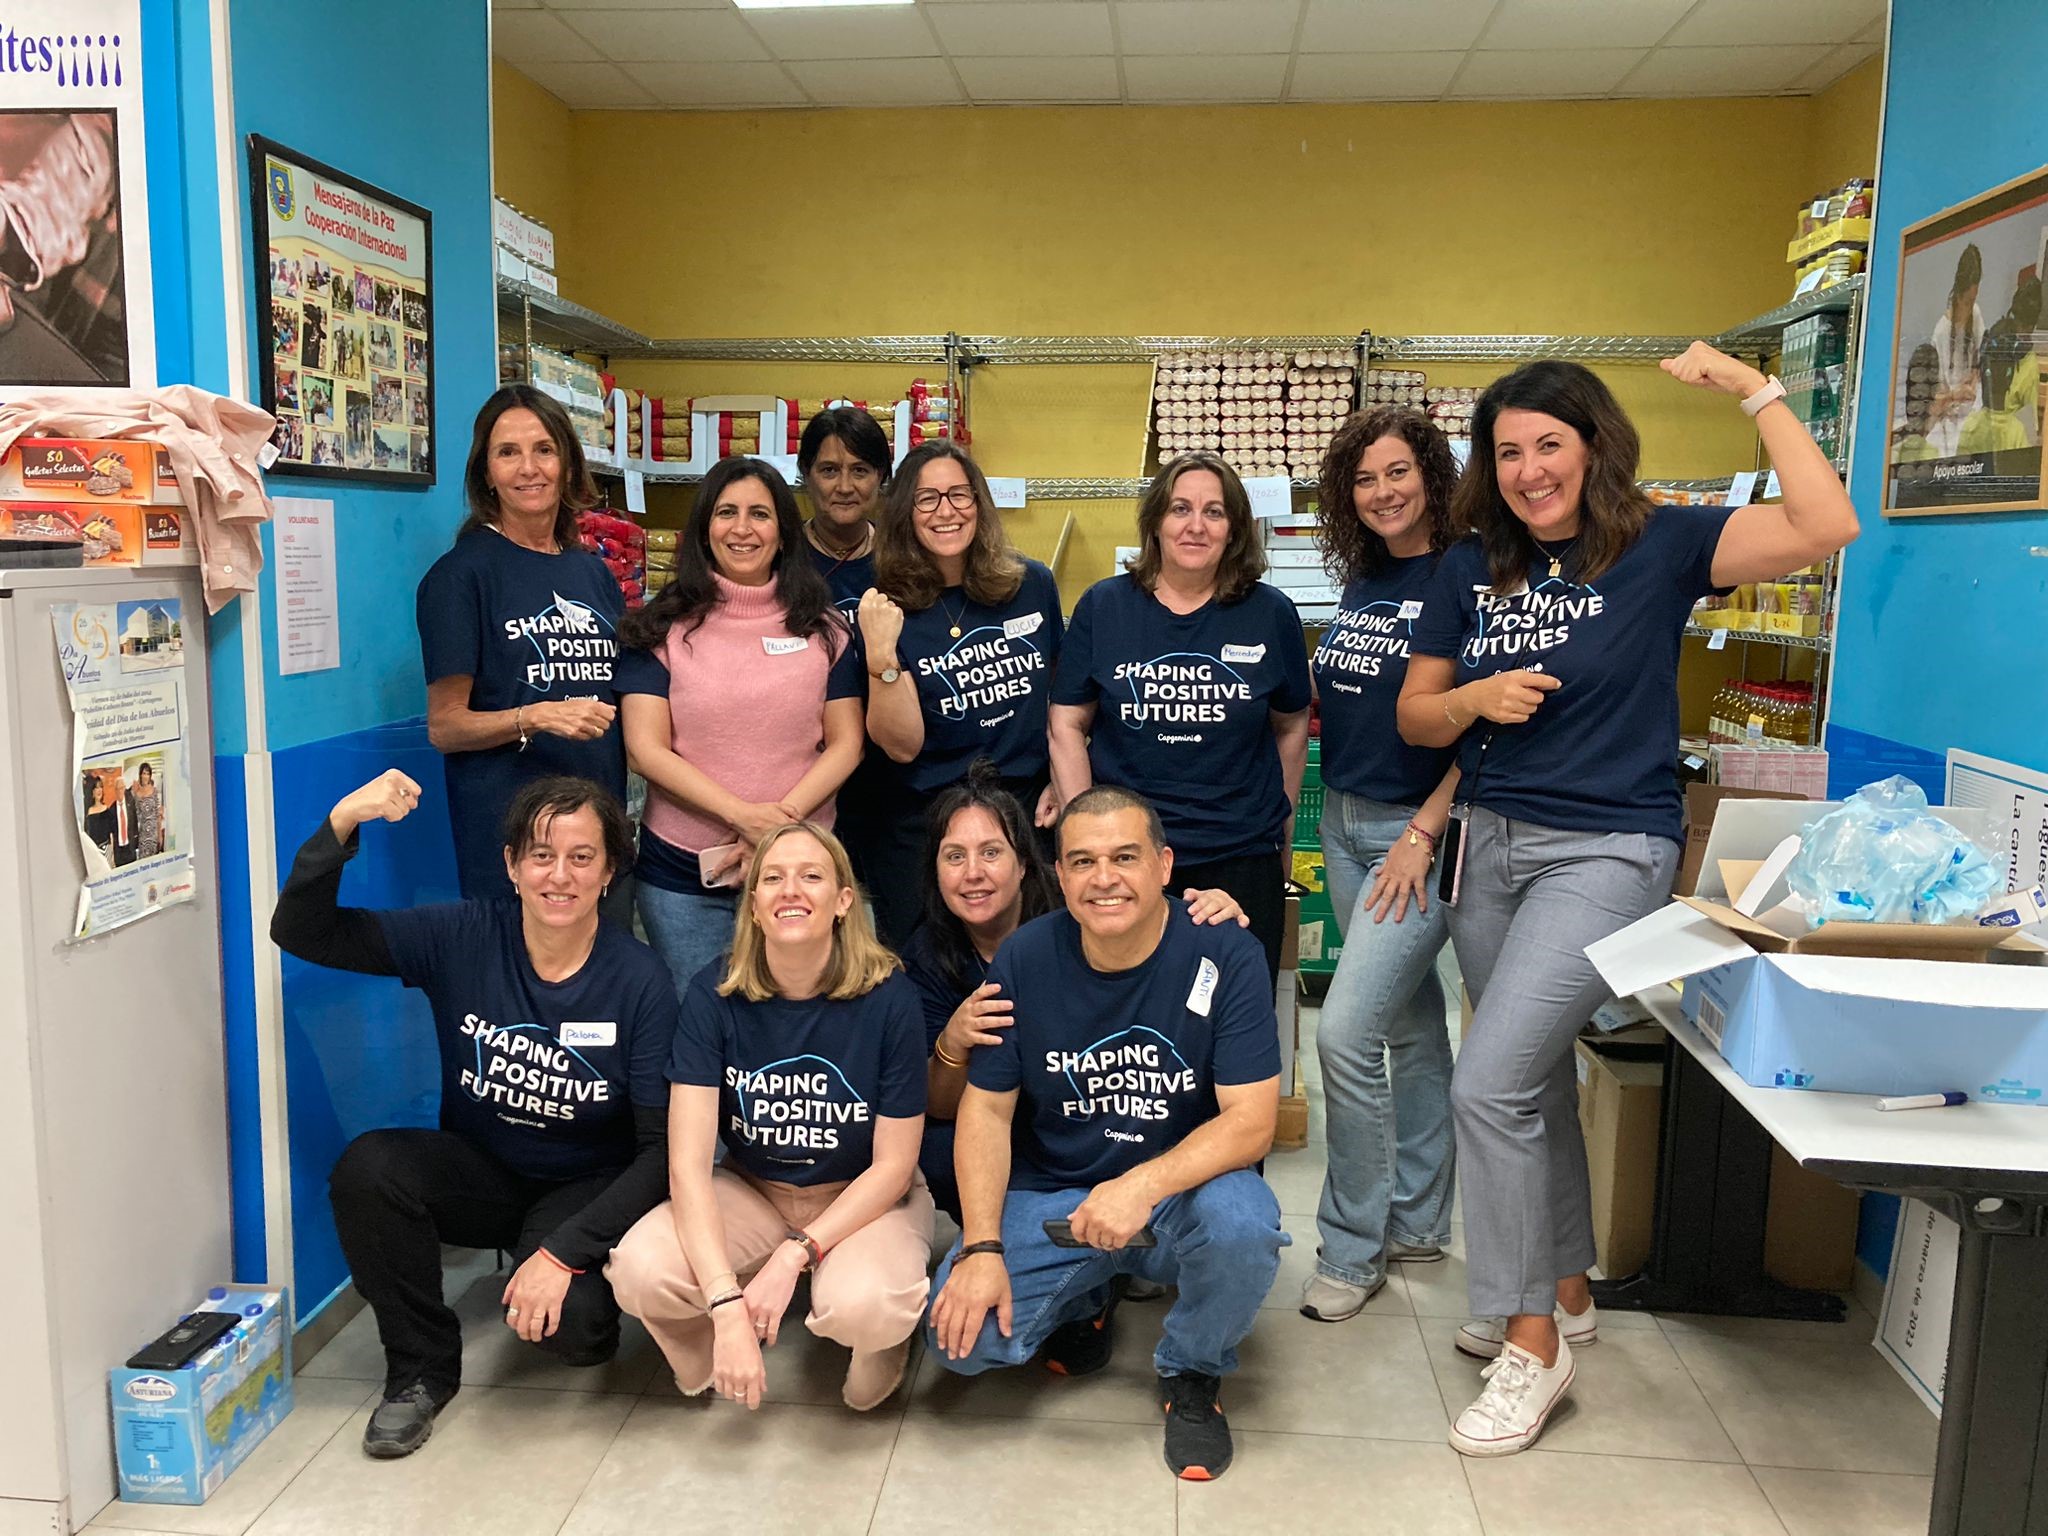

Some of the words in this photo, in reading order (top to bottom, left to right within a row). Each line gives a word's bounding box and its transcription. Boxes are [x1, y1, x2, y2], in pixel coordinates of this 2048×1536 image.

[313, 181, 361, 218] Mensajeros
[361, 201, 371, 222] de
[371, 204, 379, 226] la
[380, 210, 396, 232] Paz
[304, 205, 357, 242] Cooperación
[357, 226, 408, 262] Internacional
[46, 450, 64, 462] 80
[24, 465, 53, 478] Galletas
[53, 463, 85, 475] Selectas
[1933, 464, 1956, 480] Apoyo
[1956, 460, 1985, 476] escolar
[504, 615, 600, 641] SHAPING
[1006, 616, 1038, 636] LUCIE
[546, 637, 619, 659] POSITIV
[917, 637, 1010, 676] SHAPING
[1312, 645, 1383, 677] FUTURES
[526, 662, 613, 684] FUTURES
[955, 651, 1045, 689] POSITIVE
[1112, 661, 1212, 681] SHAPING
[939, 676, 1033, 715] FUTURES
[1143, 682, 1253, 701] POSITIVE
[105, 715, 116, 726] del
[129, 711, 138, 721] de
[149, 706, 176, 718] Abuelos
[1120, 702, 1226, 722] FUTURES
[1157, 733, 1194, 744] Capgemini
[2013, 793, 2025, 819] La
[459, 1013, 571, 1073] SHAPING
[565, 1028, 603, 1042] Paloma
[1045, 1044, 1160, 1073] SHAPING
[487, 1055, 610, 1102] POSITIVE
[725, 1066, 829, 1096] SHAPING
[1087, 1068, 1197, 1095] POSITIVE
[459, 1068, 576, 1121] FUTURES
[1062, 1094, 1170, 1120] FUTURES
[753, 1099, 870, 1124] POSITIVE
[731, 1115, 840, 1149] FUTURES
[1924, 1210, 1937, 1231] de
[1917, 1235, 1932, 1284] marzo
[1913, 1286, 1923, 1307] de
[1905, 1310, 1919, 1349] 2023
[129, 1386, 173, 1397] ASTURIANA
